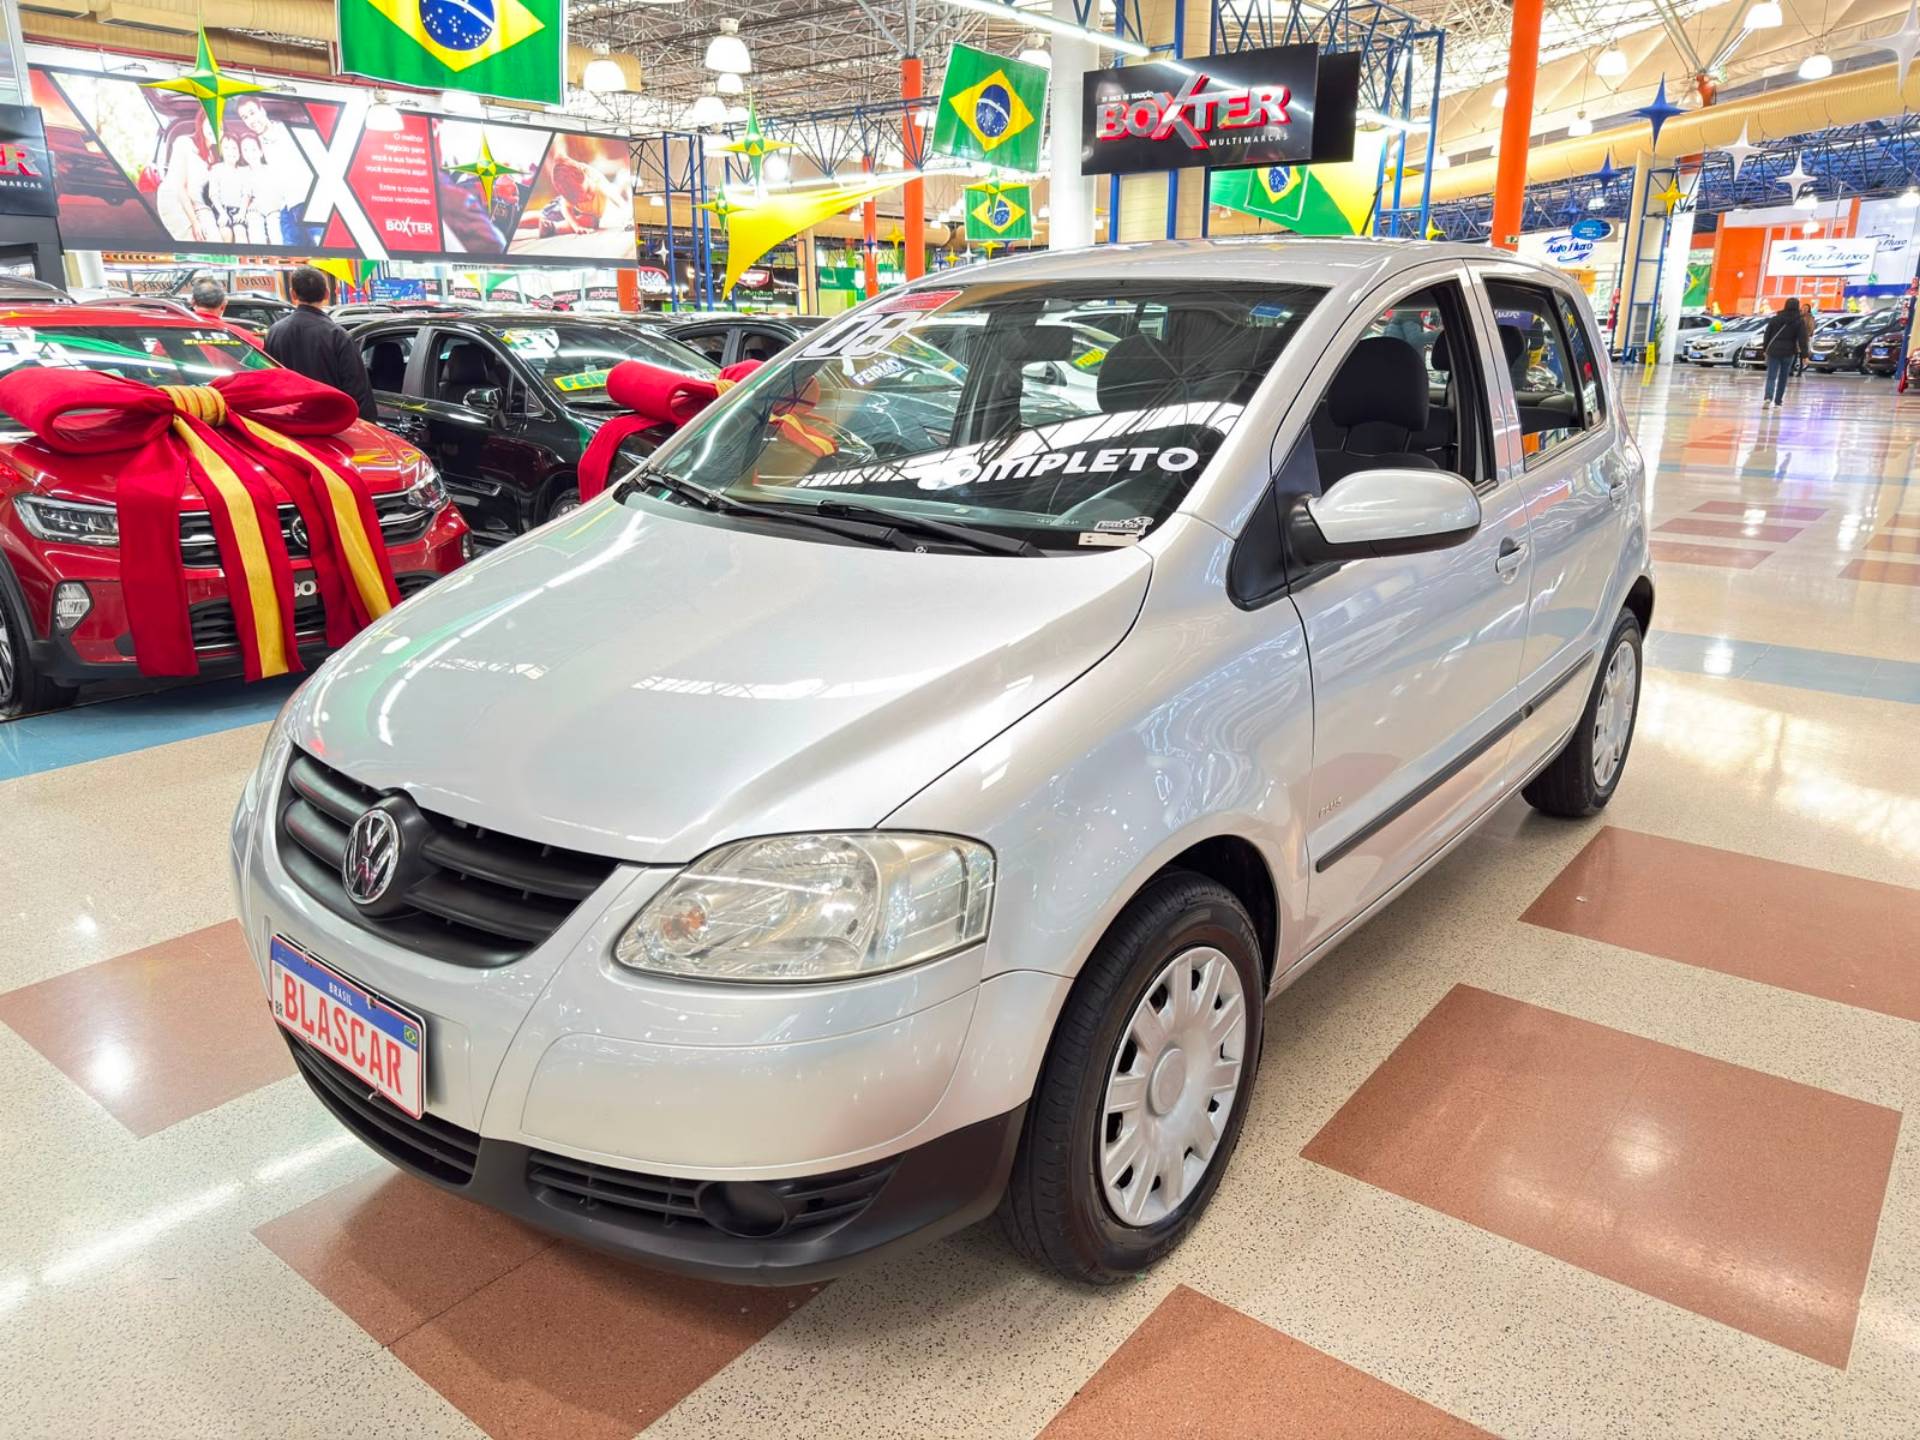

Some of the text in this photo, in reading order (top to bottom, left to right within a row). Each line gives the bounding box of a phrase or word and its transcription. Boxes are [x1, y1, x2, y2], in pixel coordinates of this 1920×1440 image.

[1097, 73, 1291, 150] BOXTER
[1209, 133, 1289, 147] MULTIMARCAS
[385, 216, 433, 237] BOXTER
[803, 312, 924, 357] 08
[328, 981, 353, 1007] BRASIL
[284, 973, 403, 1097] BLASCAR
